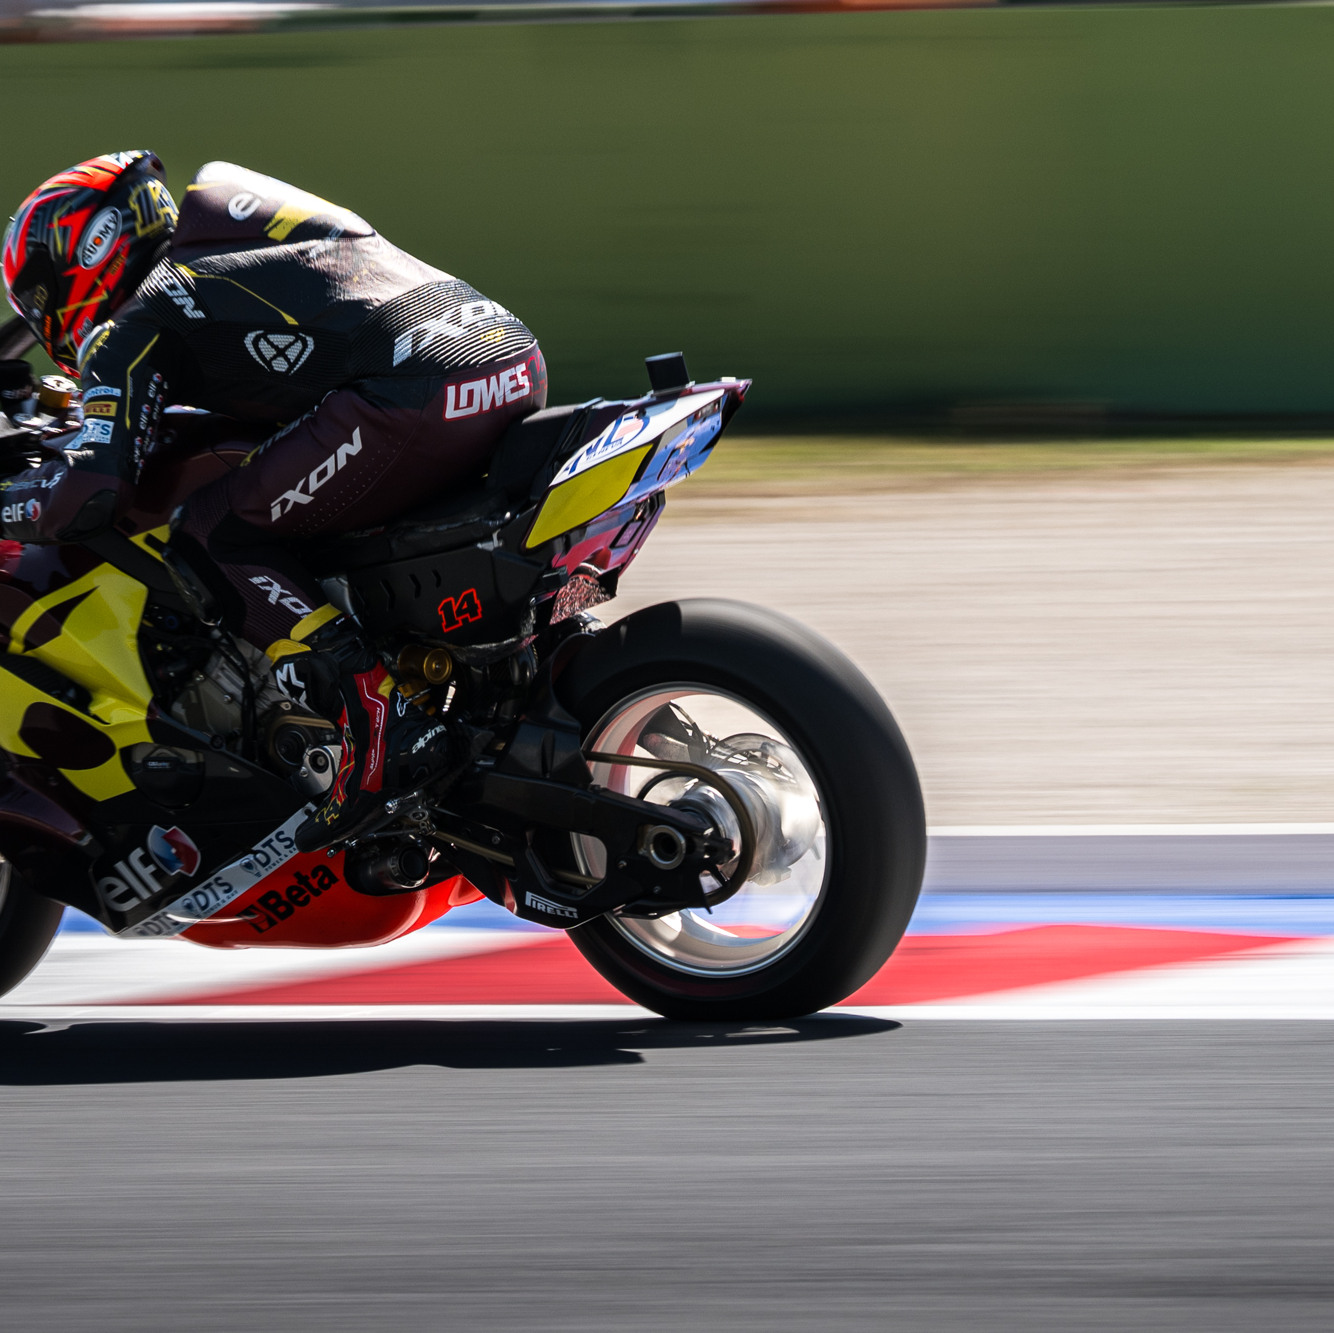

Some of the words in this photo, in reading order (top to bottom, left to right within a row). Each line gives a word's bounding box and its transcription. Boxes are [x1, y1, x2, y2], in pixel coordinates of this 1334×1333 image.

[444, 362, 530, 420] LOWES
[1, 502, 25, 523] elf
[438, 588, 482, 633] 14
[253, 830, 295, 867] DTS
[98, 846, 163, 913] elf
[191, 875, 234, 912] DTS
[258, 863, 340, 922] Beta
[525, 891, 578, 919] PIRELLI
